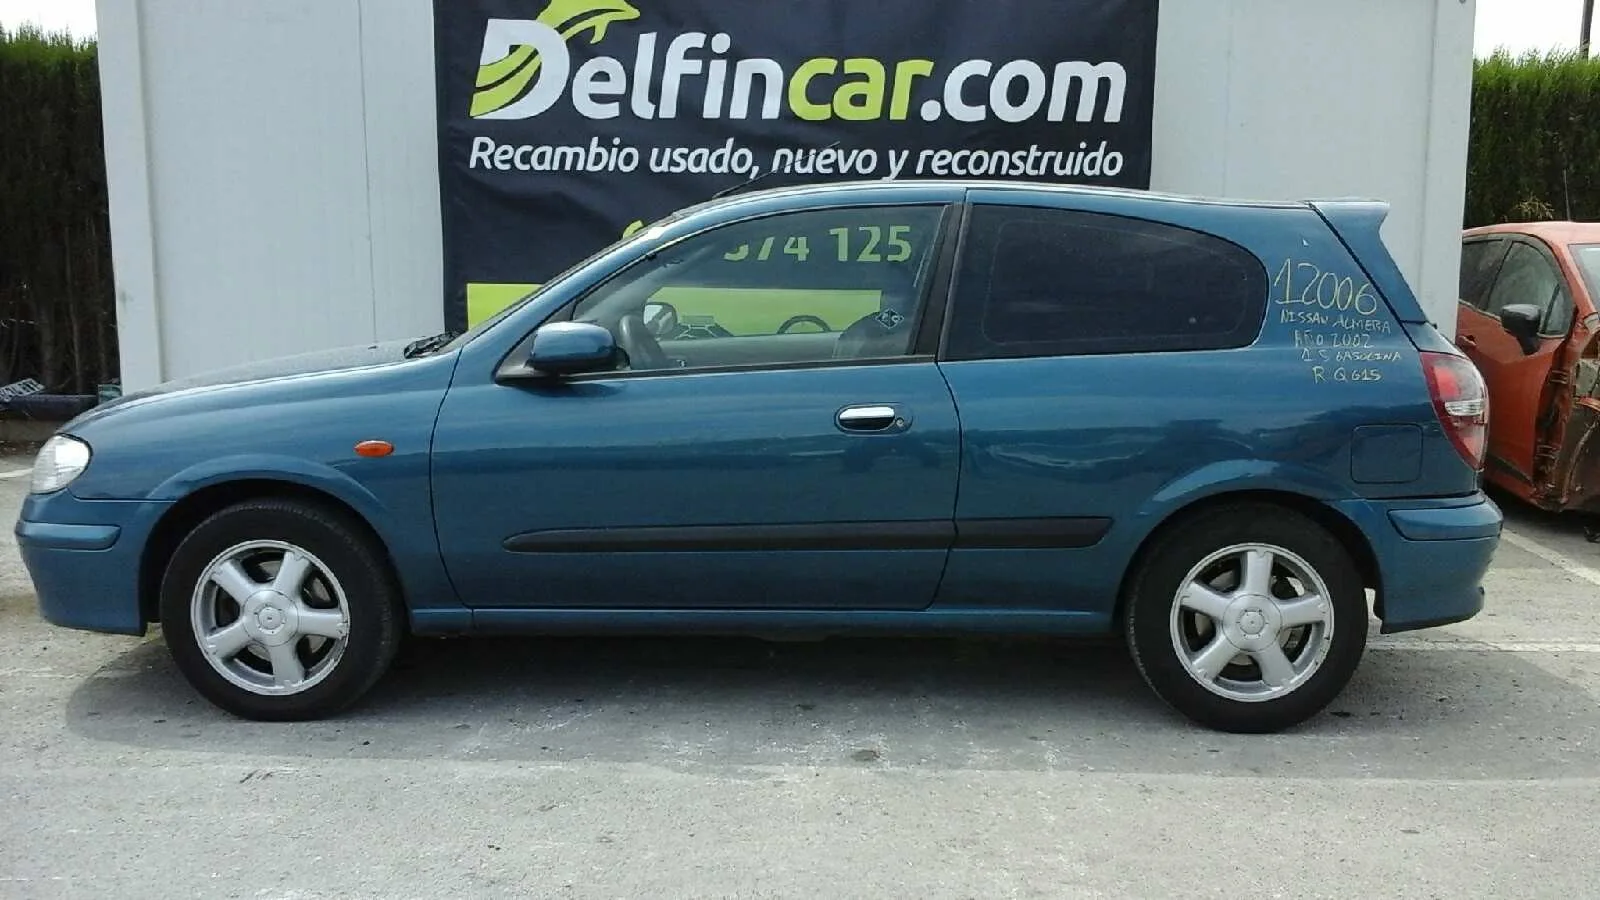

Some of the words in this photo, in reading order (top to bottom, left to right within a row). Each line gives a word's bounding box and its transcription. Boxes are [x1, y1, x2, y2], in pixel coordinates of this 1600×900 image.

[469, 136, 639, 173] Recambio
[649, 138, 760, 180] usado,
[771, 148, 878, 175] nuevo
[881, 149, 910, 181] y
[915, 141, 1124, 177] reconstruido
[829, 225, 912, 263] 125
[1274, 257, 1377, 315] 12006
[1280, 309, 1329, 325] NISSAN
[1330, 333, 1375, 349] 2002
